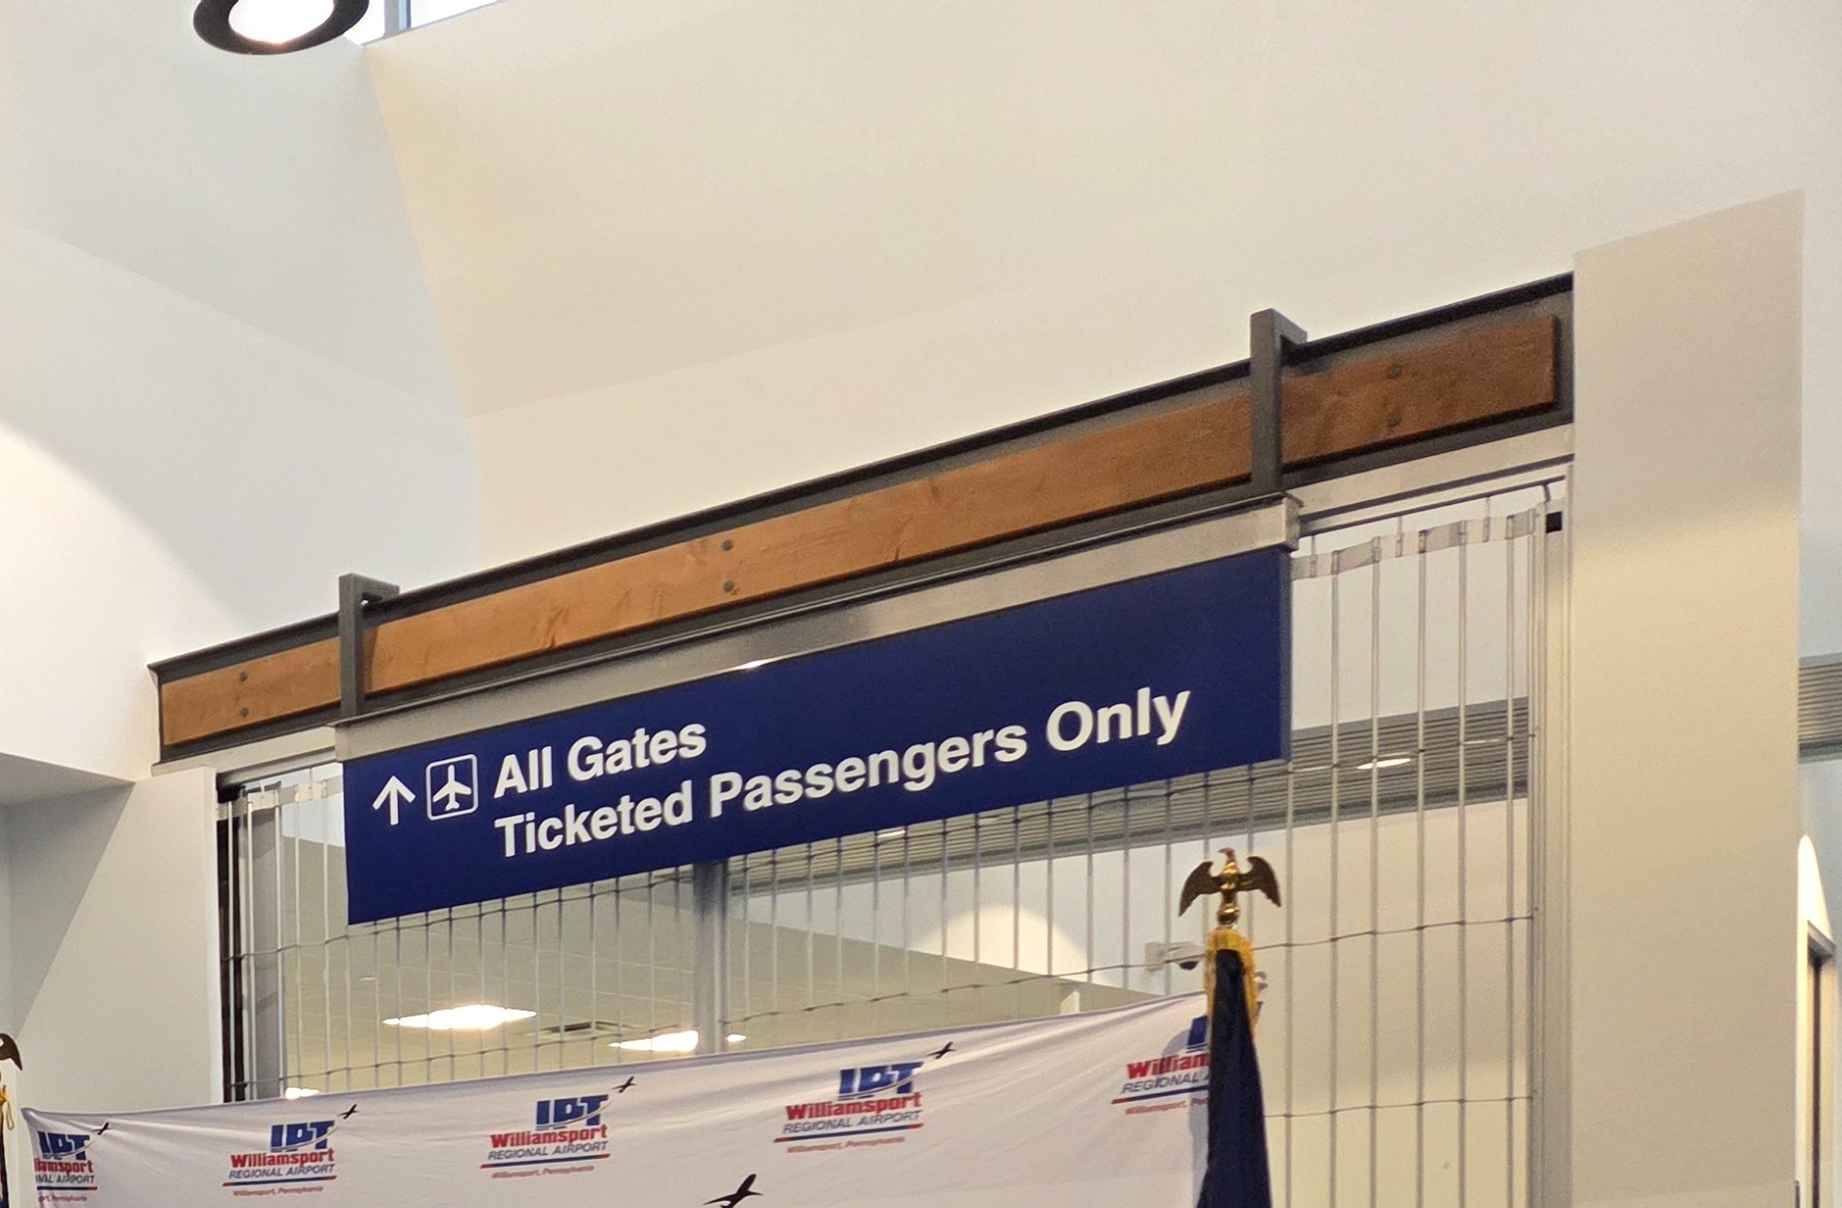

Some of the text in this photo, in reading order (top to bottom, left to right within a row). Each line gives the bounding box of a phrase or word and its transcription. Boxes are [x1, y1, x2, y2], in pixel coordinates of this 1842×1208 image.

[493, 723, 707, 799] All Gates
[494, 686, 1191, 858] Ticketed Passengers Only
[838, 1061, 924, 1100] IPT
[1122, 1072, 1200, 1094] REGIONAL
[536, 1094, 609, 1131] IPT
[786, 1092, 922, 1121] Williamsport
[270, 1120, 335, 1152] IPT
[490, 1124, 607, 1148] Williamsport
[783, 1110, 923, 1134] REGIONAL AIRPORT
[37, 1131, 91, 1160] IPT
[230, 1148, 335, 1168] Williamsport
[488, 1141, 608, 1160] REGIONAL AIRPORT
[228, 1163, 336, 1179] REGIONAL AIRPORT
